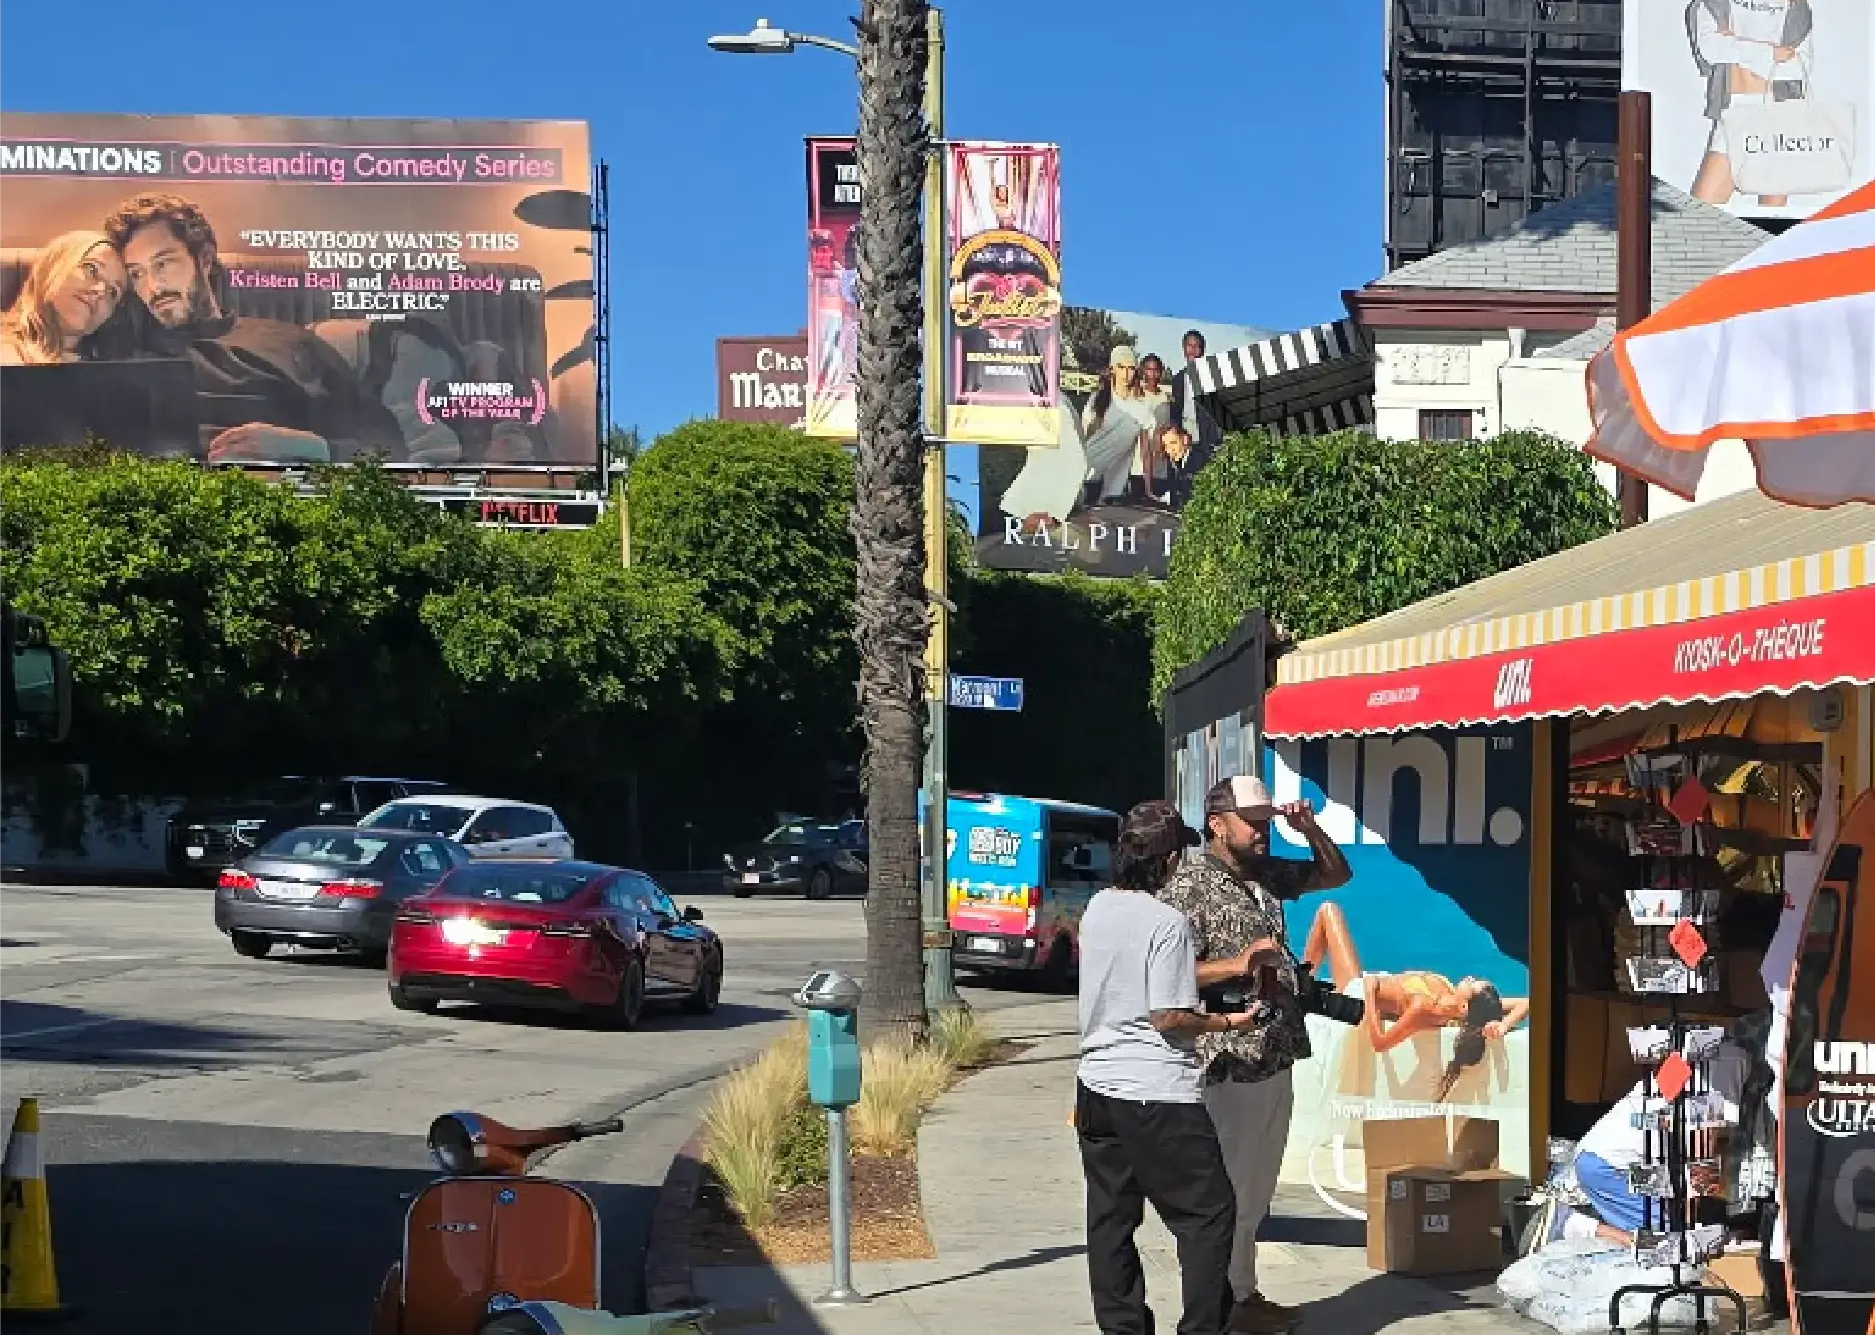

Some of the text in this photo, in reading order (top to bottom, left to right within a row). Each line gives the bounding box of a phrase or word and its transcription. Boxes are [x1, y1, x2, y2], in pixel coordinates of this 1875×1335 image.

[0, 145, 555, 183] MINATIONS Outstanding Comedy Series
[384, 230, 463, 250] WANTS
[465, 230, 519, 251] THIS
[307, 250, 467, 271] KIND OF LOVE.
[229, 269, 542, 296] Kristen Bell and Adam Brody are
[756, 347, 808, 372] Cha
[448, 382, 514, 396] WINNER
[730, 372, 807, 409] Mar
[1003, 516, 1138, 555] RALPH
[1274, 734, 1523, 848] uni.
